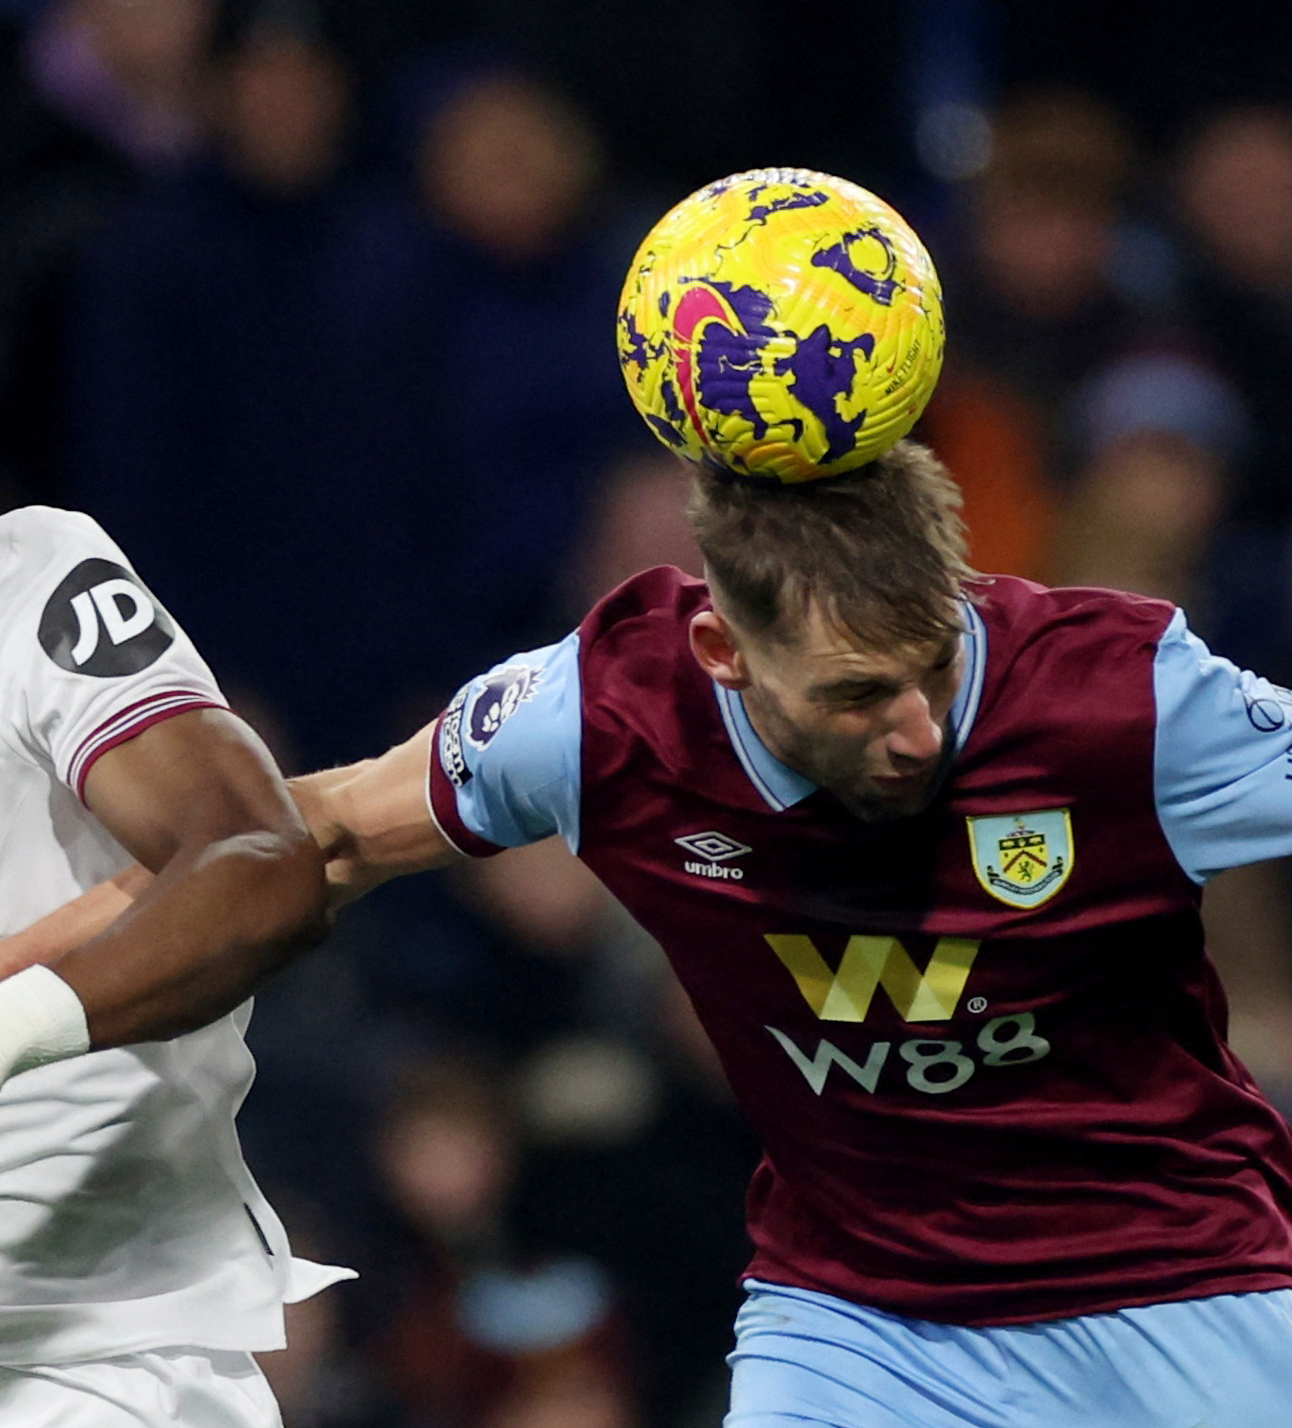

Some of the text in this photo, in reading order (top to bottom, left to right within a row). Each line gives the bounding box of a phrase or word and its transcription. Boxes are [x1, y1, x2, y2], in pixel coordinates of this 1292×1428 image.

[69, 577, 156, 667] JD
[684, 860, 744, 880] umbro
[764, 1012, 1051, 1097] W88
